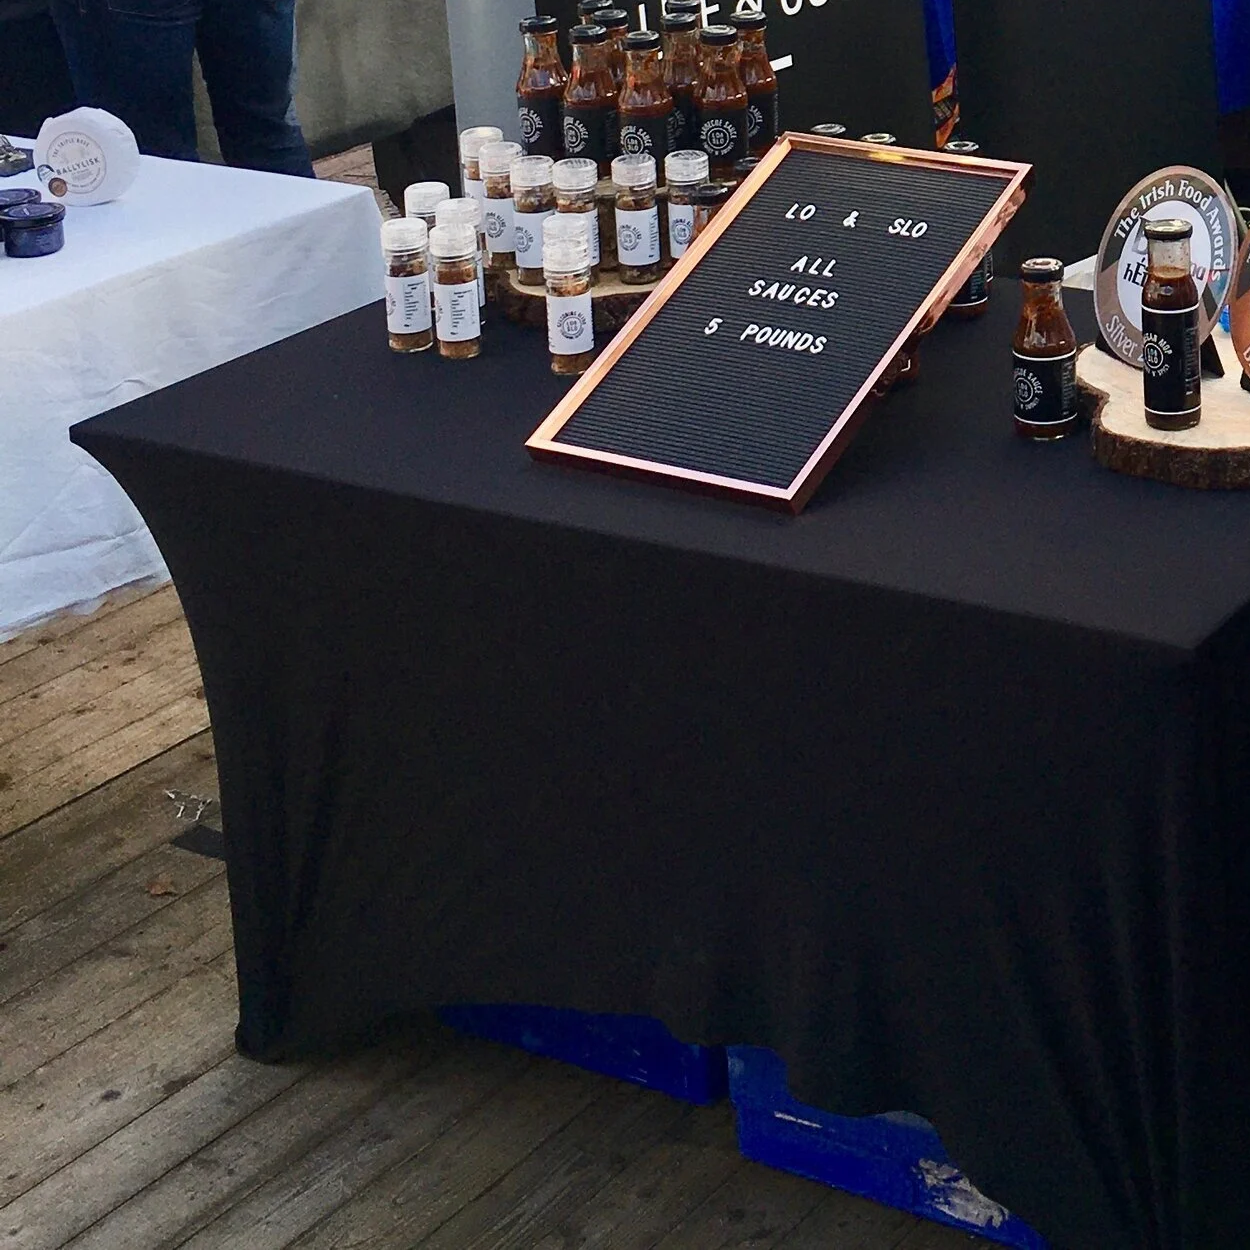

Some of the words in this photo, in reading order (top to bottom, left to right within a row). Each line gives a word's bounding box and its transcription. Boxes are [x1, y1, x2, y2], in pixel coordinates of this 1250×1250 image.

[56, 156, 100, 176] BALLYLISK
[785, 203, 816, 221] LO
[842, 210, 860, 229] &
[888, 217, 928, 238] SLO
[1113, 206, 1141, 240] The
[1139, 179, 1175, 210] Irish
[1178, 178, 1215, 213] Food
[1206, 207, 1227, 282] Awards
[790, 255, 837, 278] ALL
[748, 279, 839, 309] SAUCES
[704, 317, 724, 335] 5
[740, 323, 828, 354] POUNDS
[1105, 314, 1138, 359] Silver
